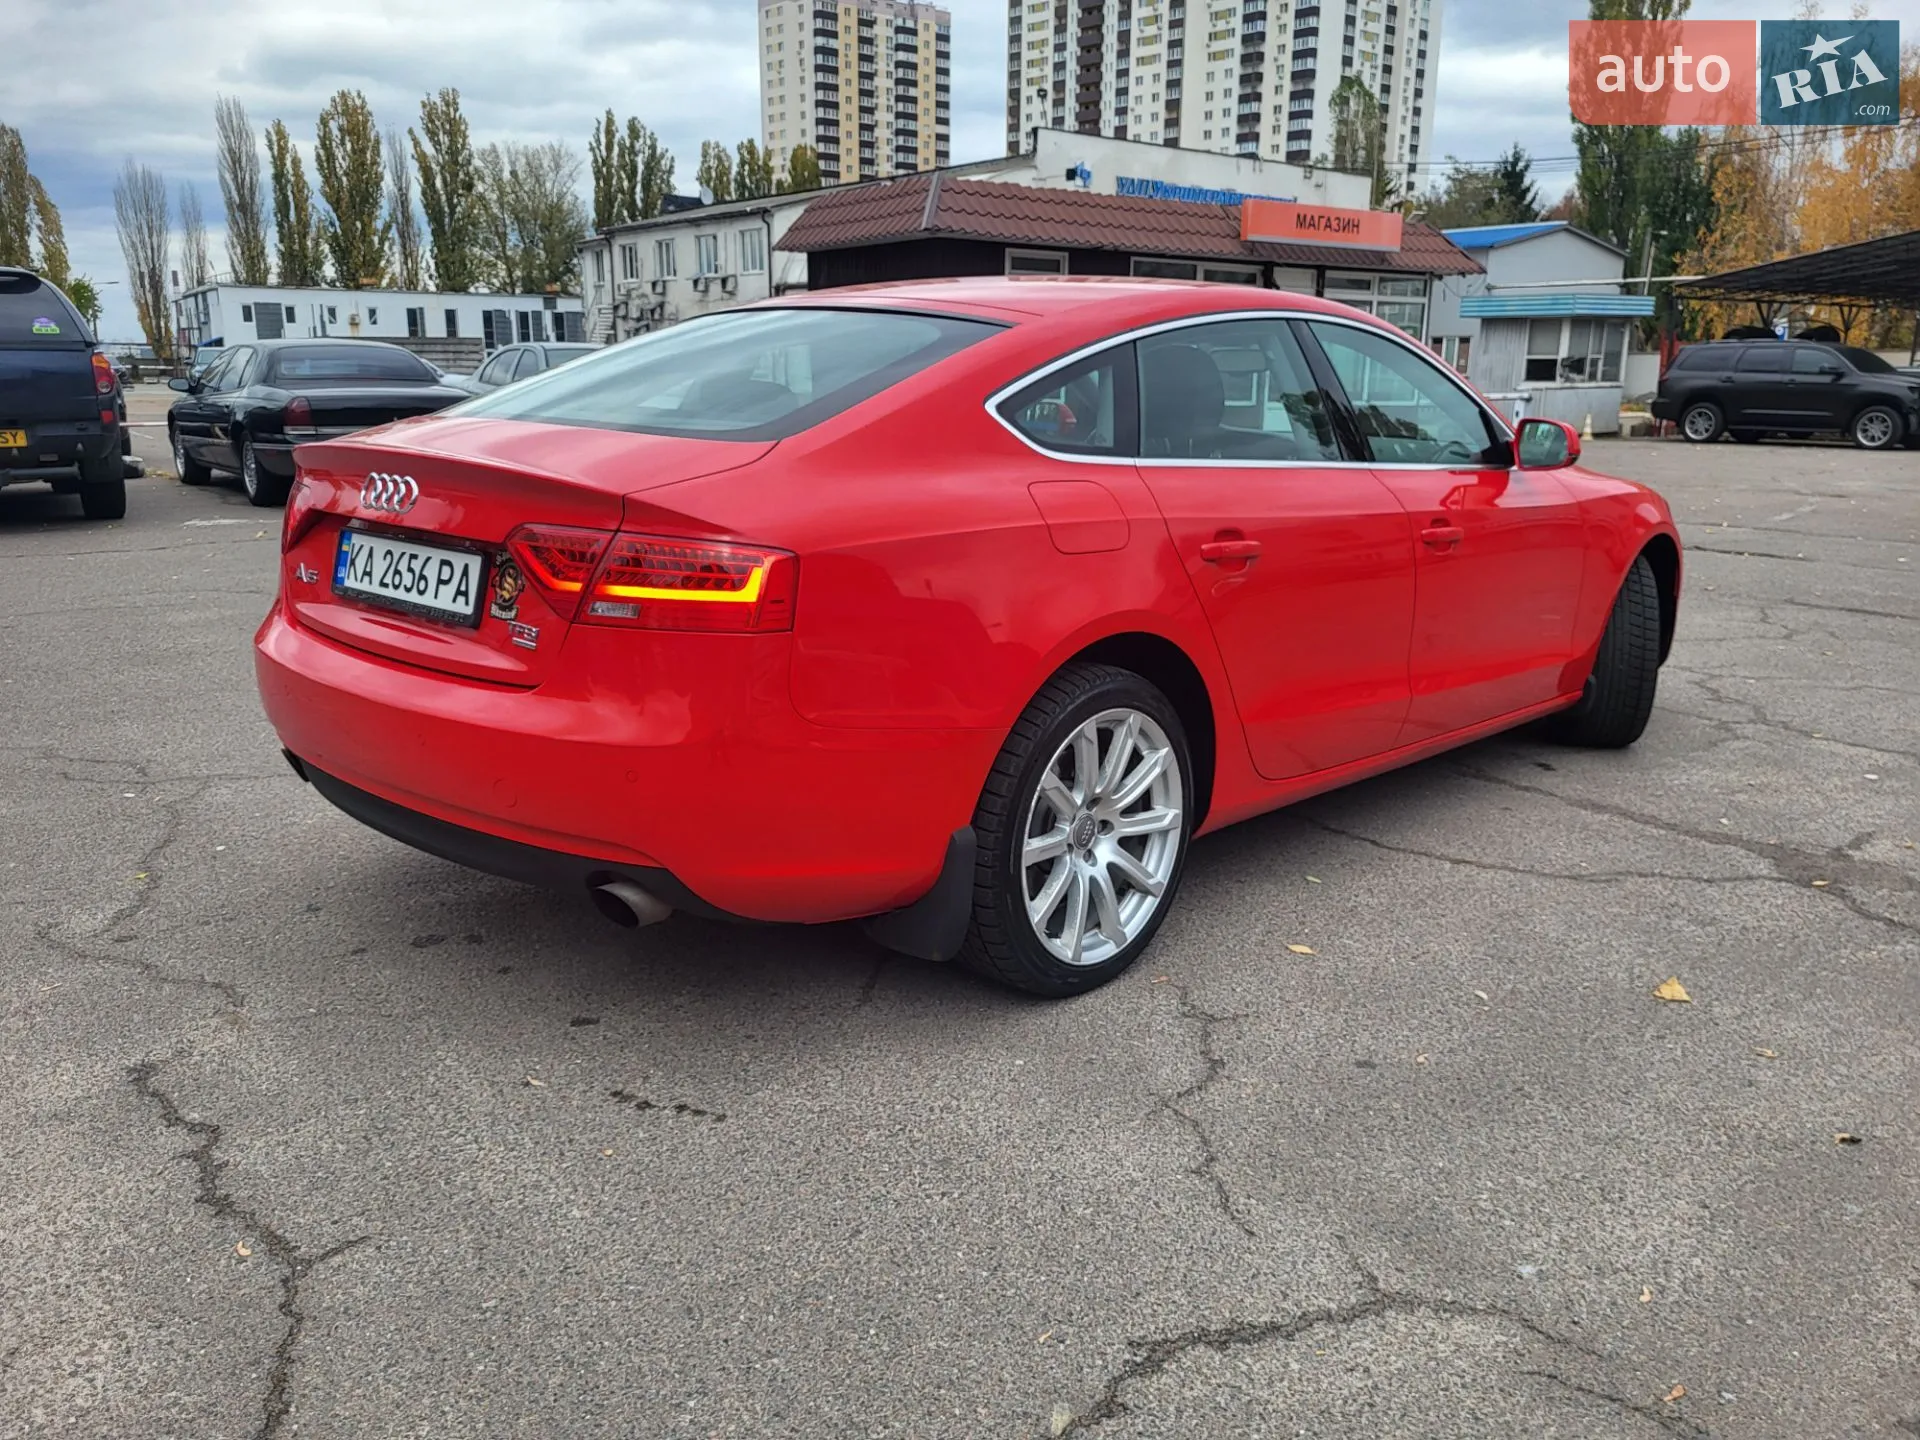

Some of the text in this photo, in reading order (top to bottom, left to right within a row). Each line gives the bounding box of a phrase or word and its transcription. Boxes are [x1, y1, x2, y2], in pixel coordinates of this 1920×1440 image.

[1296, 212, 1360, 235] МАГАЗИН
[347, 543, 471, 607] KA 2656 PA
